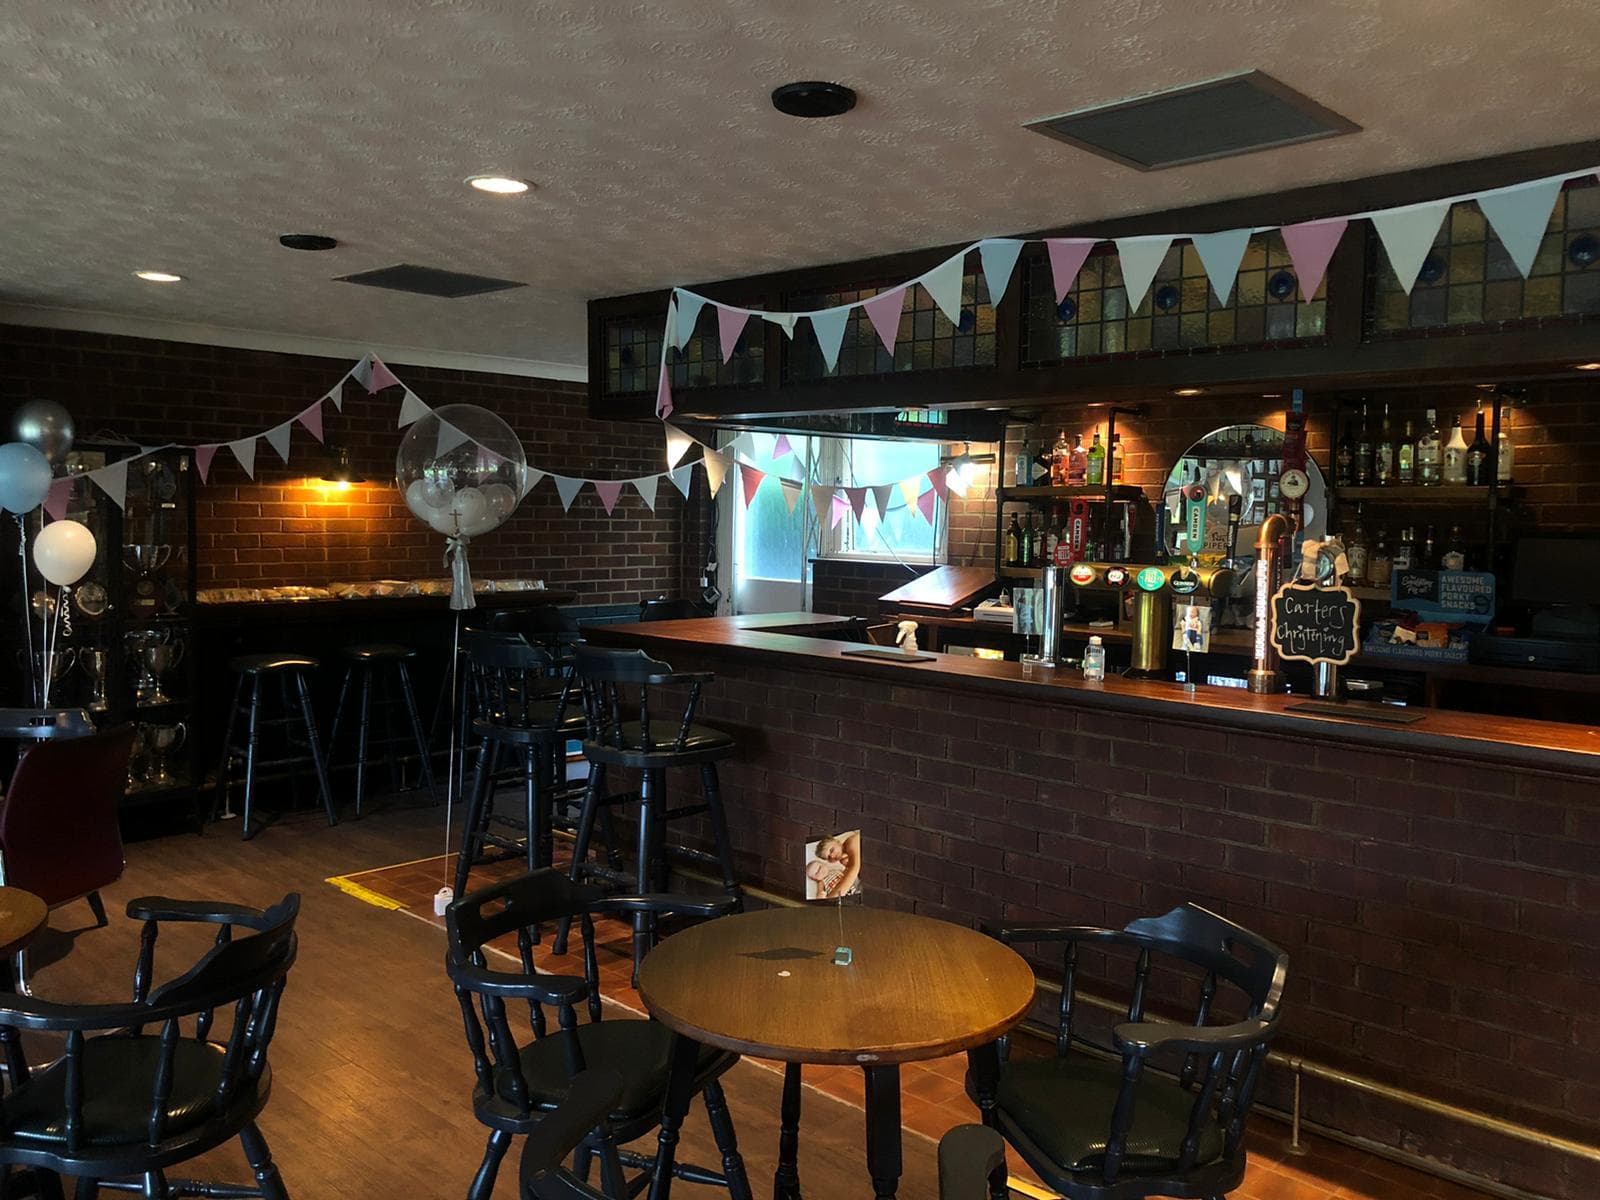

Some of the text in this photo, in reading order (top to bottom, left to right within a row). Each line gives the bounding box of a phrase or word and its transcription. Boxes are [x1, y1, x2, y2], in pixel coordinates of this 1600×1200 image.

[1192, 508, 1200, 538] CAMDEN
[1441, 575, 1485, 585] AWESOME
[1441, 584, 1492, 593] FLAVOURED
[1441, 592, 1470, 601] PORKY
[1441, 600, 1476, 610] SNACKS
[1286, 597, 1347, 628] Carters
[1276, 622, 1345, 656] Christening
